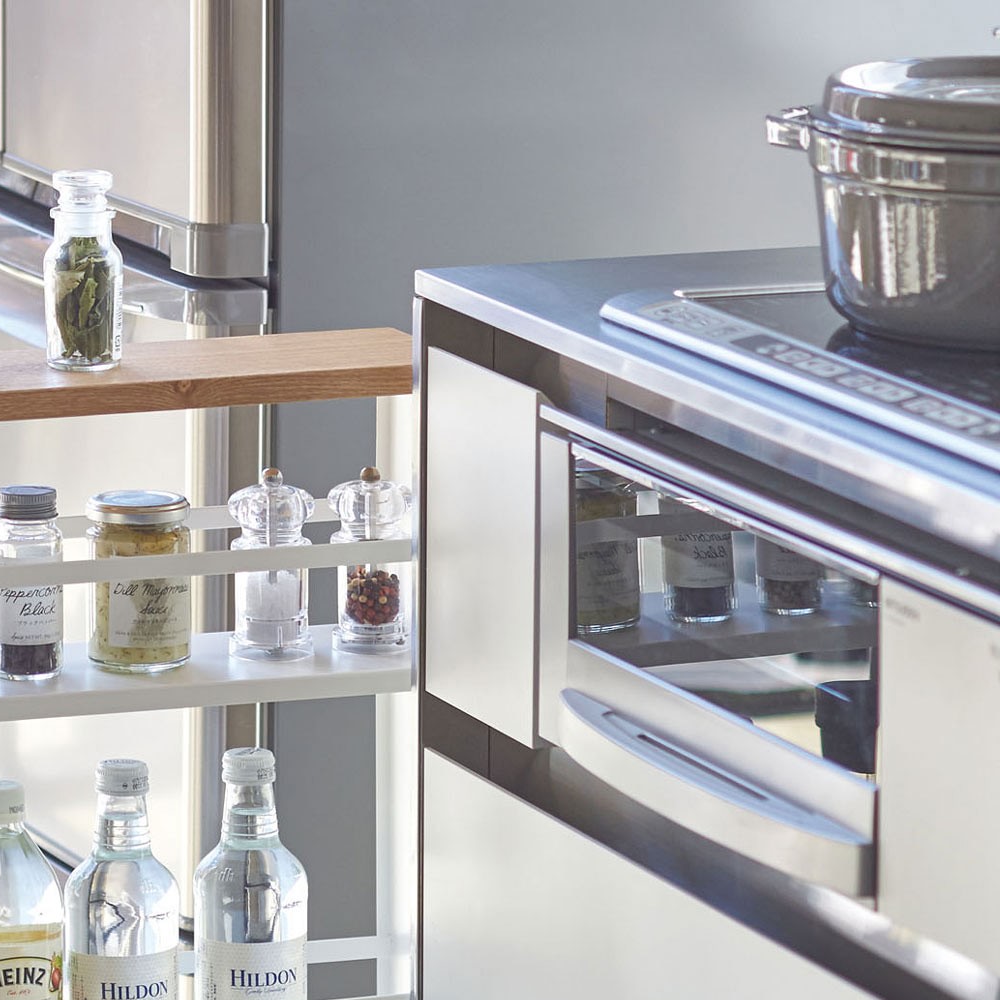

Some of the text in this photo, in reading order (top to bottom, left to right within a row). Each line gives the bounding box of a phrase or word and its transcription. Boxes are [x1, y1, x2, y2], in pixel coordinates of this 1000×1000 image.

[113, 582, 139, 597] Dill
[20, 600, 56, 617] Black
[230, 967, 297, 988] HILDON
[100, 980, 168, 1000] HILDON
